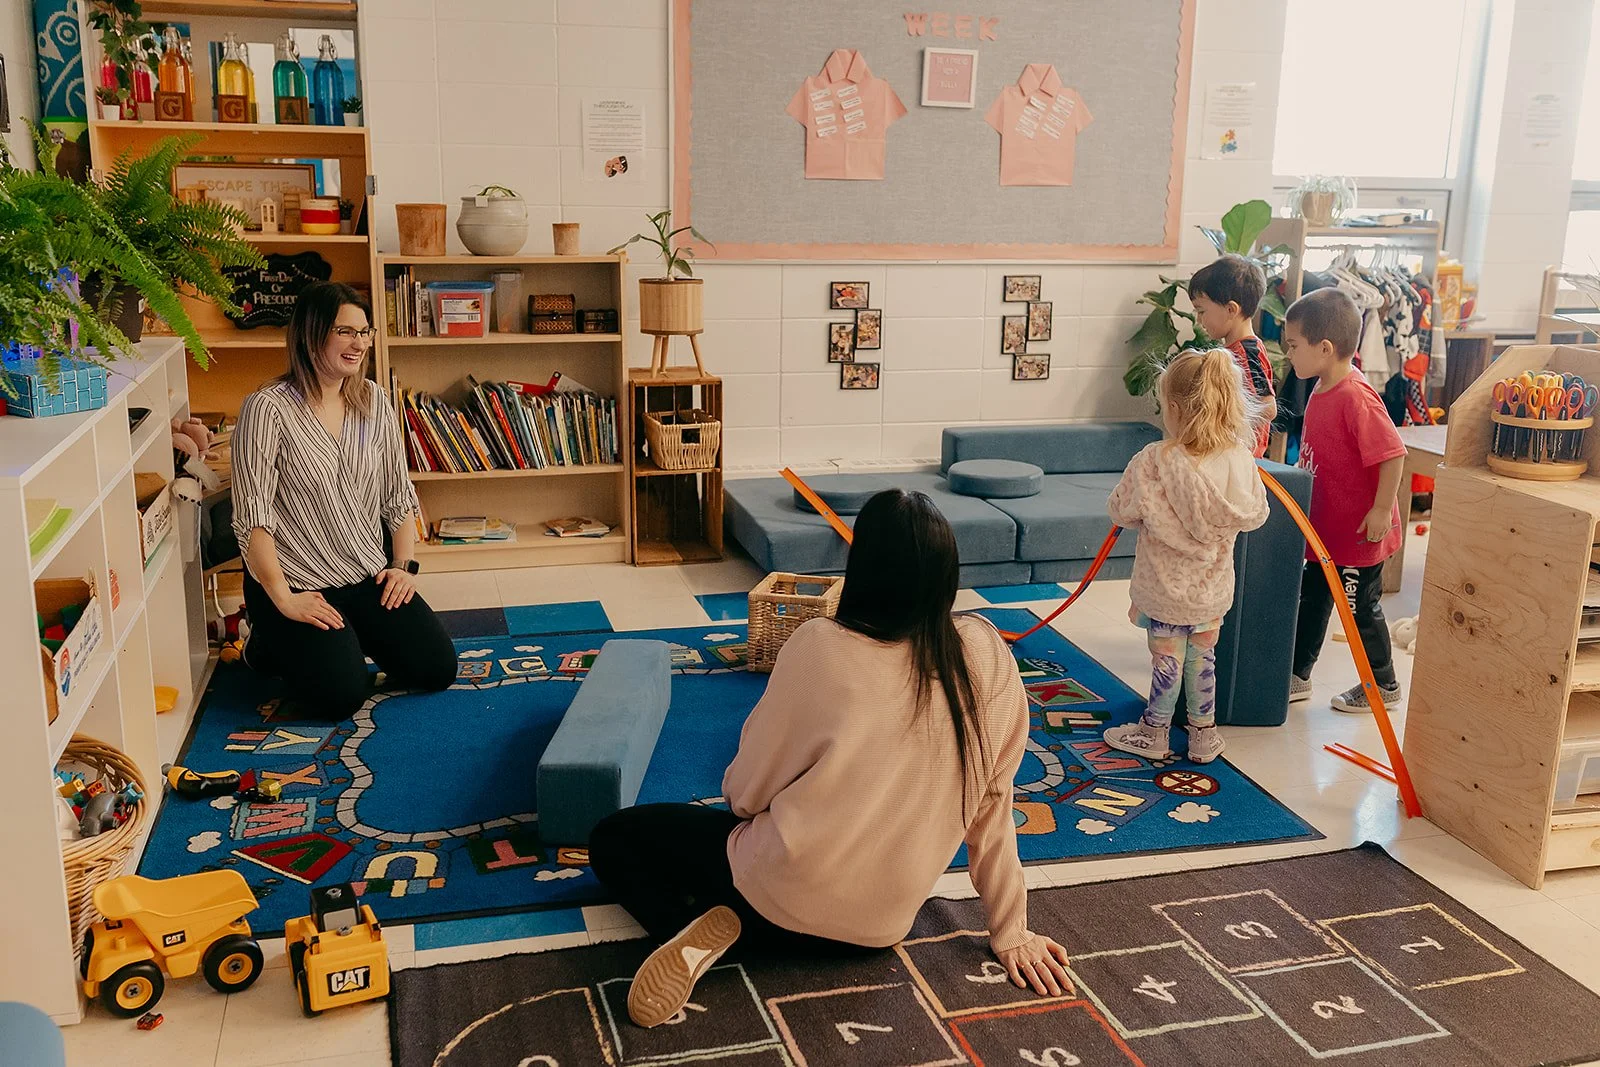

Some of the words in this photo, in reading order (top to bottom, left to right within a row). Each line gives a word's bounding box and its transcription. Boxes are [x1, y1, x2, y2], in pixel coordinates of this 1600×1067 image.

[902, 13, 1000, 41] WEEK
[162, 98, 181, 117] G
[223, 100, 242, 119] G
[285, 99, 297, 120] A
[457, 661, 487, 677] B
[507, 659, 544, 671] C
[1026, 683, 1086, 701] K
[262, 729, 322, 751] Y
[1070, 741, 1144, 771] M
[261, 763, 322, 788] X
[1074, 787, 1146, 816] N
[243, 803, 307, 838] W
[255, 839, 335, 871] V
[363, 850, 438, 879] U
[486, 840, 538, 869] T
[165, 933, 184, 945] CAT
[1224, 921, 1278, 939] 3
[1400, 936, 1445, 954] 1
[330, 967, 370, 993] CAT
[1132, 974, 1177, 1004] 4
[1311, 995, 1365, 1019] 2
[835, 1021, 893, 1044] 7
